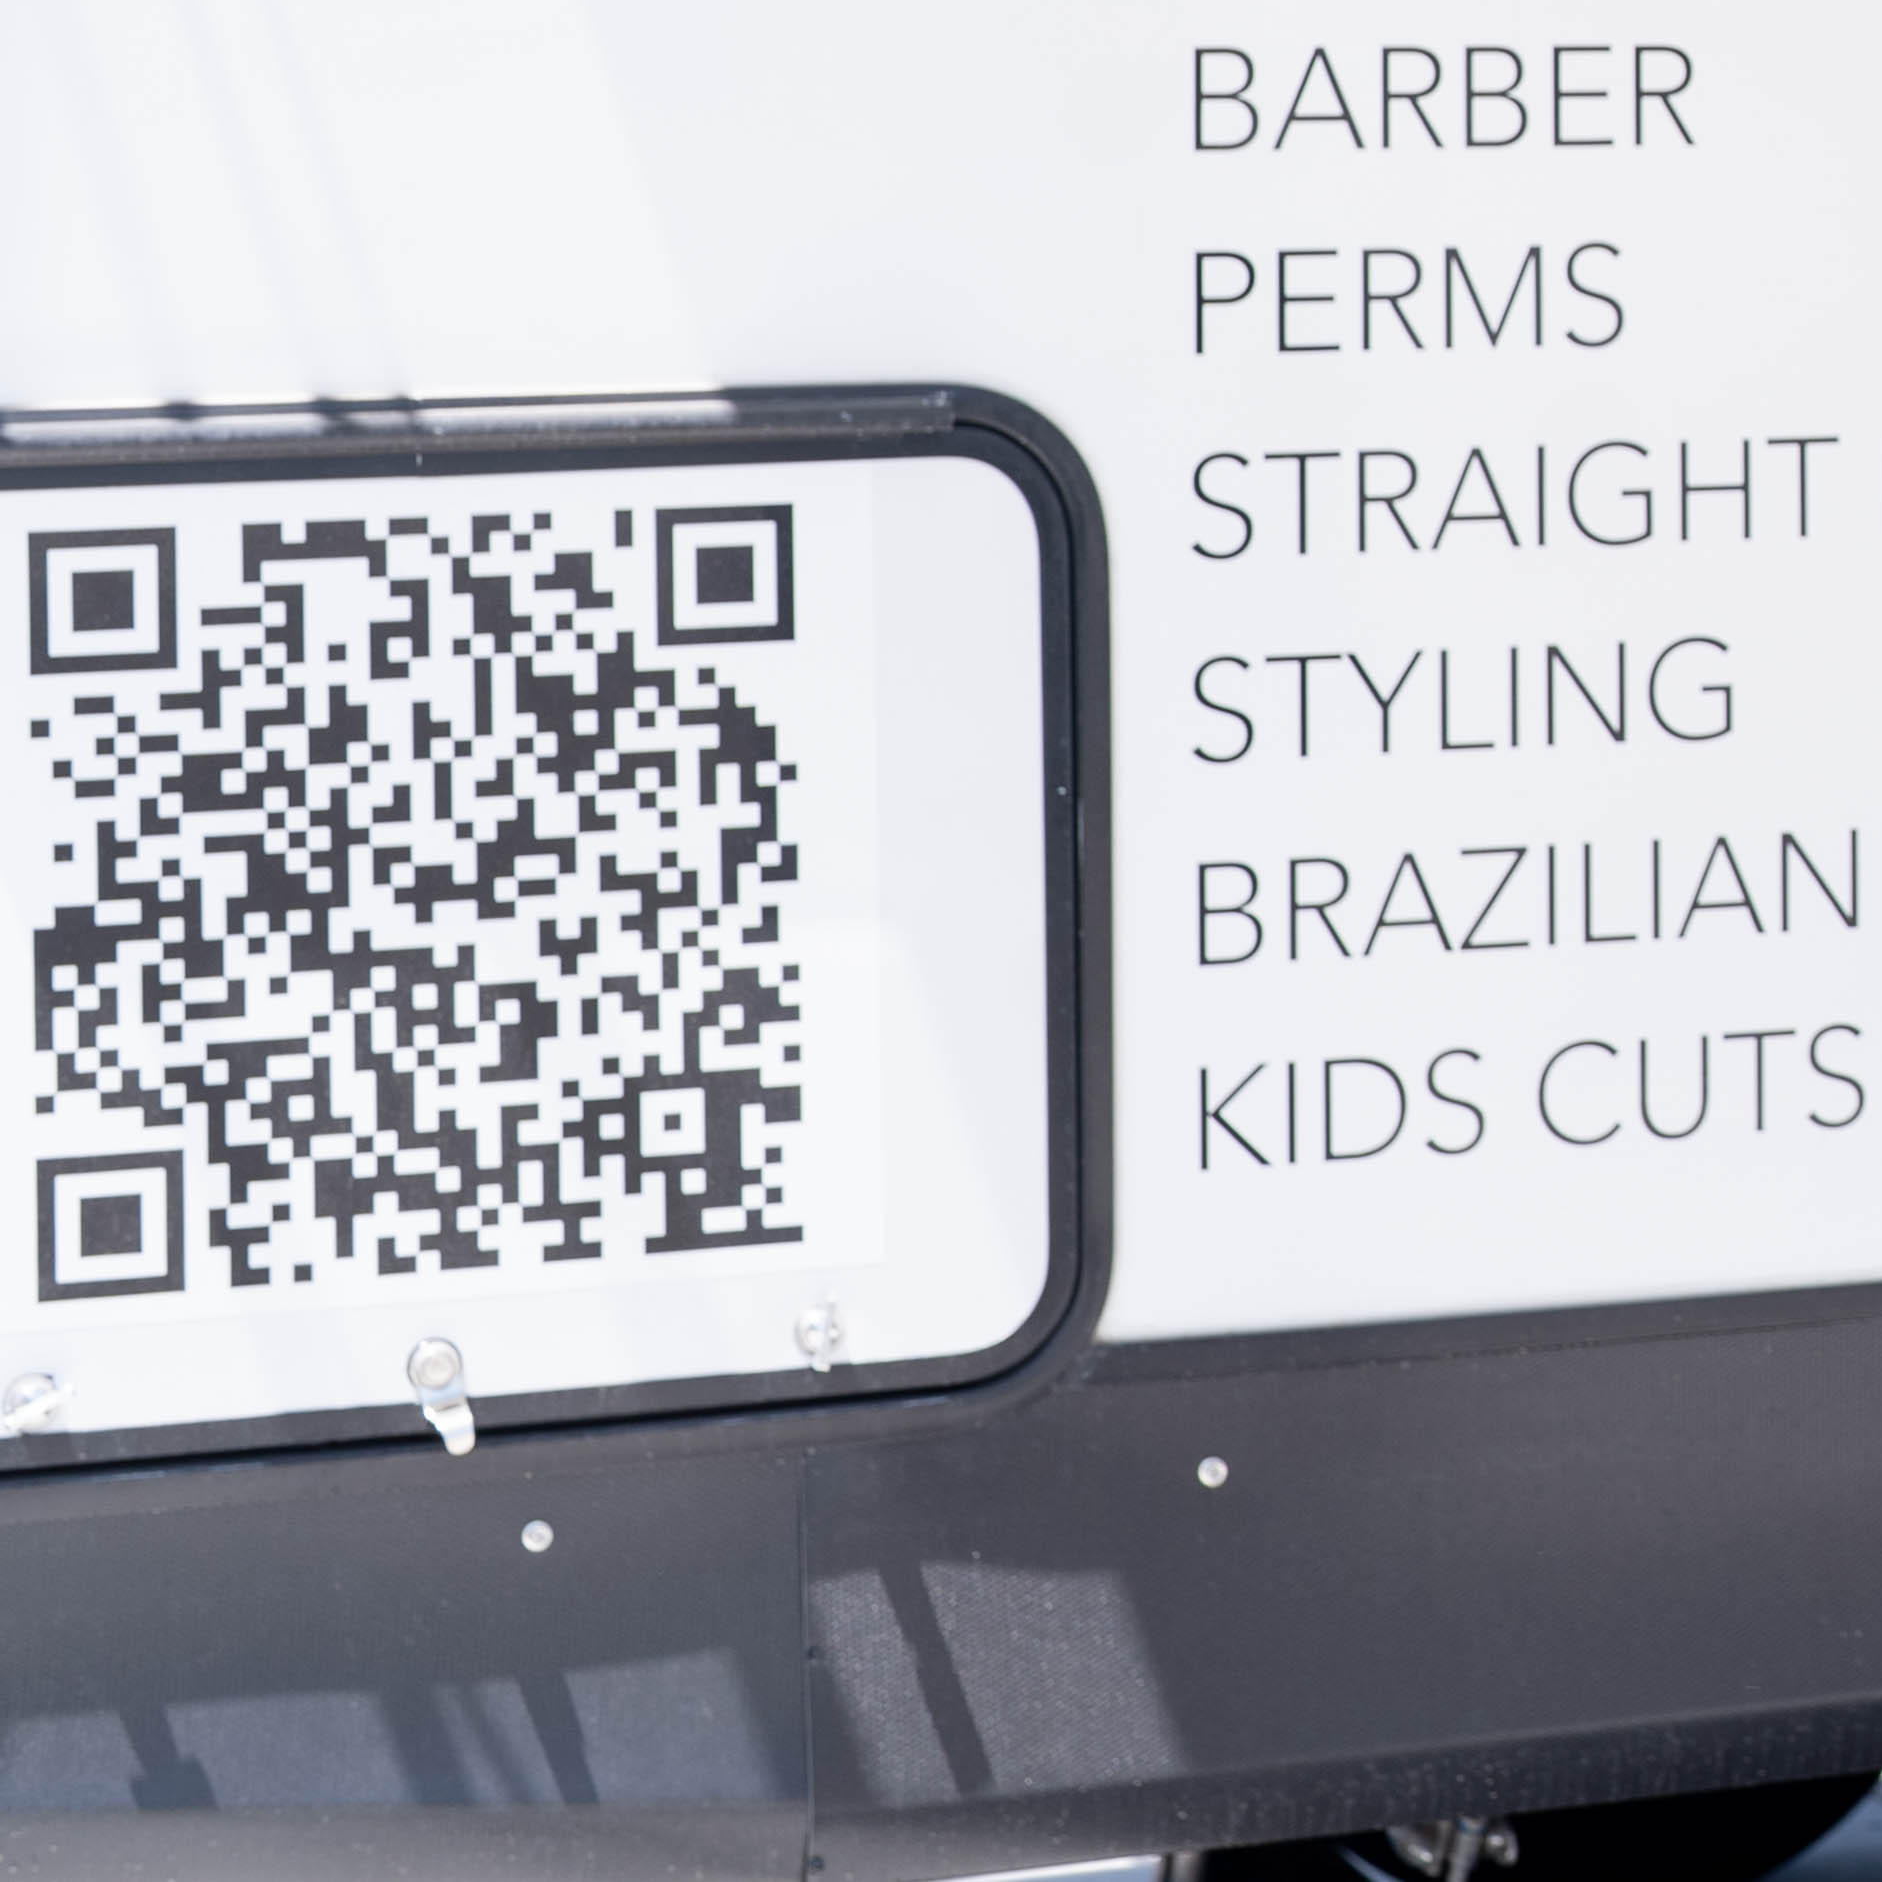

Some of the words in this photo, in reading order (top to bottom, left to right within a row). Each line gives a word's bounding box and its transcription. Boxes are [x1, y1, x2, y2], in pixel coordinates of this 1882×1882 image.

[1193, 44, 1695, 152] BARBER
[1194, 241, 1625, 356] PERMS
[1191, 436, 1840, 561] STRAIGHT
[1192, 635, 1733, 765] STYLING
[1197, 828, 1859, 968] BRAZILIAN
[1199, 1047, 1486, 1172] KIDS
[1537, 1023, 1866, 1147] CUTS
